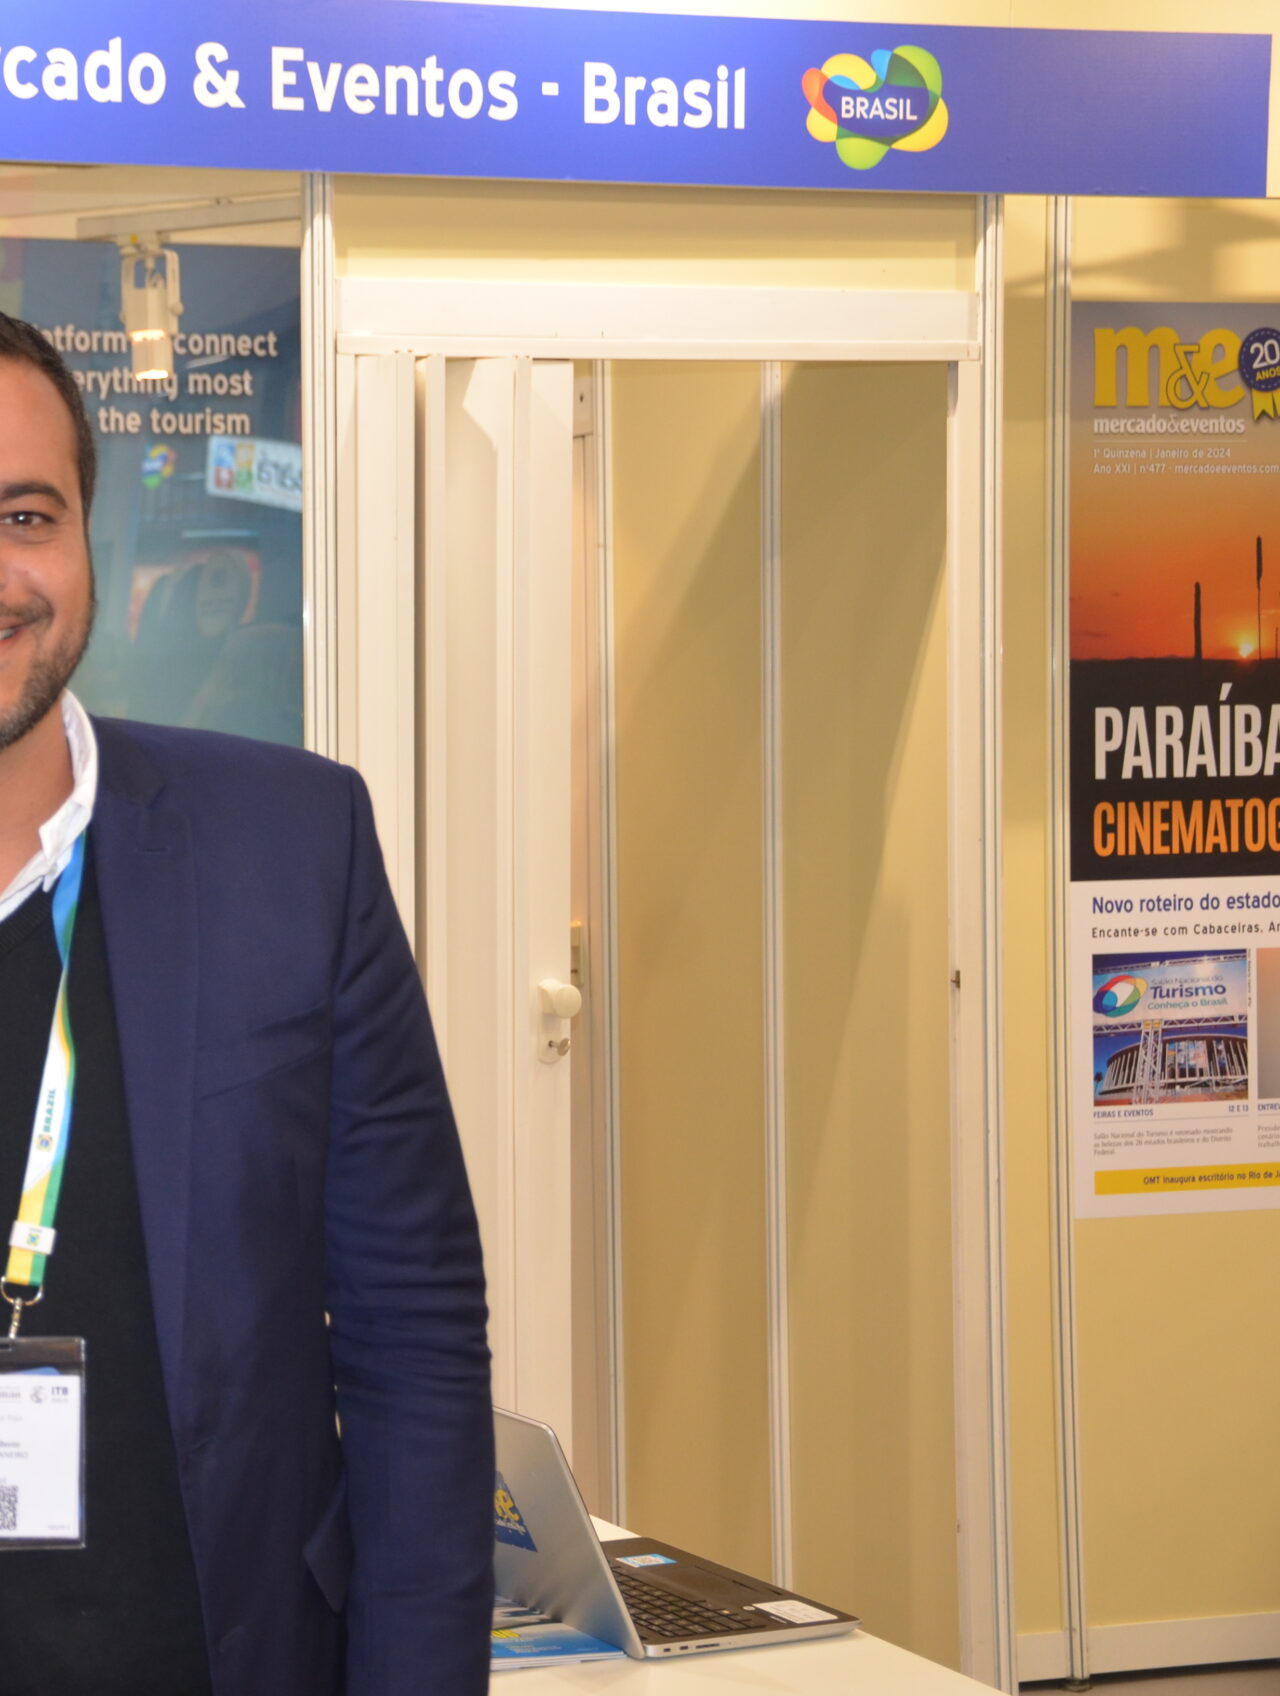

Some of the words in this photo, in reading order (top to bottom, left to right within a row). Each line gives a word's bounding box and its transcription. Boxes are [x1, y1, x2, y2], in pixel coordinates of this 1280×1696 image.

[192, 41, 246, 108] &
[270, 45, 520, 122] Eventos
[583, 61, 747, 130] Brasil
[839, 95, 919, 122] BRASIL
[32, 322, 129, 354] tform
[174, 330, 278, 358] connect
[1249, 338, 1280, 370] 20
[1093, 326, 1247, 410] m&e
[187, 368, 254, 397] most
[97, 406, 142, 434] the
[150, 407, 252, 436] tourism
[1093, 413, 1246, 436] mercado&eventos
[1103, 447, 1147, 461] Quinzena
[1155, 447, 1189, 460] Janeiro
[1192, 447, 1204, 459] de
[1207, 447, 1232, 459] 2024
[1093, 463, 1112, 474] Ano
[1115, 463, 1131, 474] XXI
[1094, 682, 1280, 780] PARAÍBA
[1093, 796, 1280, 858] CINEMATOG
[1092, 896, 1134, 914] Novo
[1139, 894, 1194, 913] roteiro
[1199, 893, 1220, 910] do
[1226, 890, 1280, 909] estado
[1092, 925, 1158, 939] Encante-se
[1163, 926, 1188, 936] com
[1150, 983, 1227, 1000] Turismo
[42, 1088, 57, 1132] BRAZIL
[1093, 1111, 1117, 1119] FEIRAS
[1123, 1108, 1154, 1118] EVENTOS
[1143, 1176, 1160, 1185] OMT
[1163, 1174, 1196, 1185] inaugura
[1198, 1171, 1234, 1183] escritório
[1248, 1170, 1262, 1179] Rio
